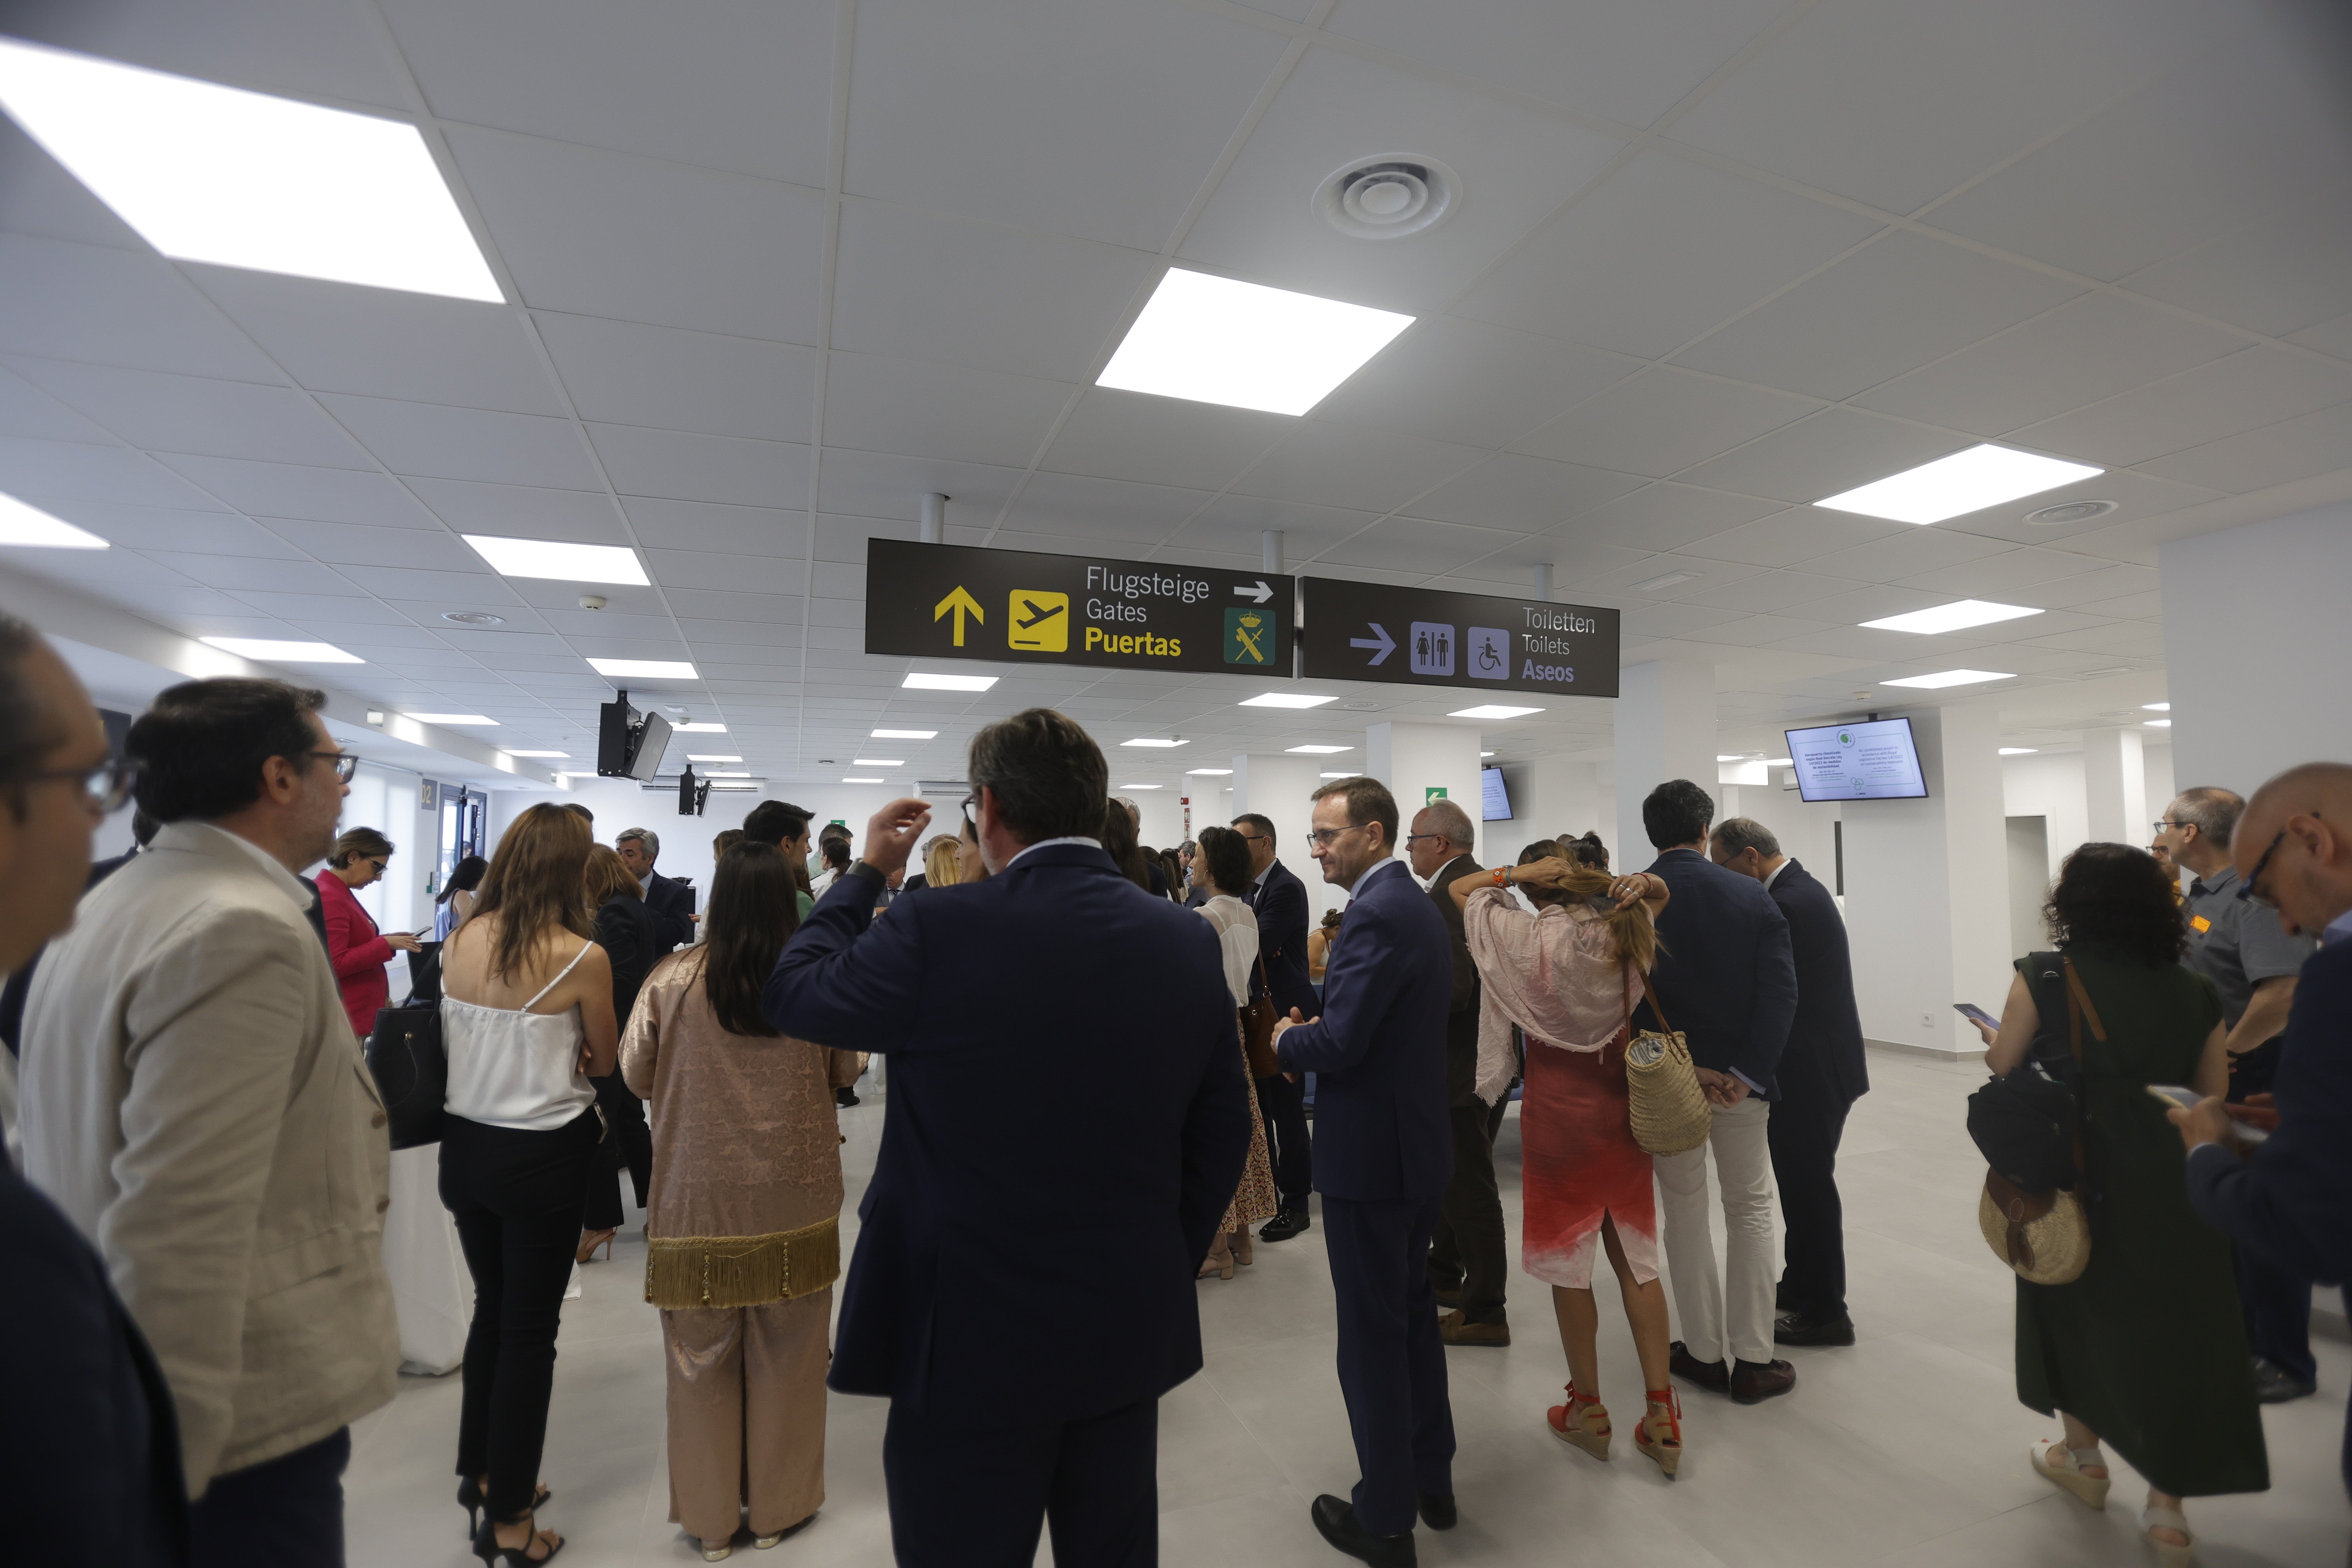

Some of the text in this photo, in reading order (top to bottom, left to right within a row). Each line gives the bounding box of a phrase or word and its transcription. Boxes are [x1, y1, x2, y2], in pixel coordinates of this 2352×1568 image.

[1087, 566, 1210, 603] Flugsteige
[1087, 599, 1147, 622] Gates
[1523, 606, 1595, 633] Toiletten
[1085, 627, 1181, 657] Puertas
[1522, 634, 1570, 655] Toilets
[1522, 659, 1574, 682] Aseos
